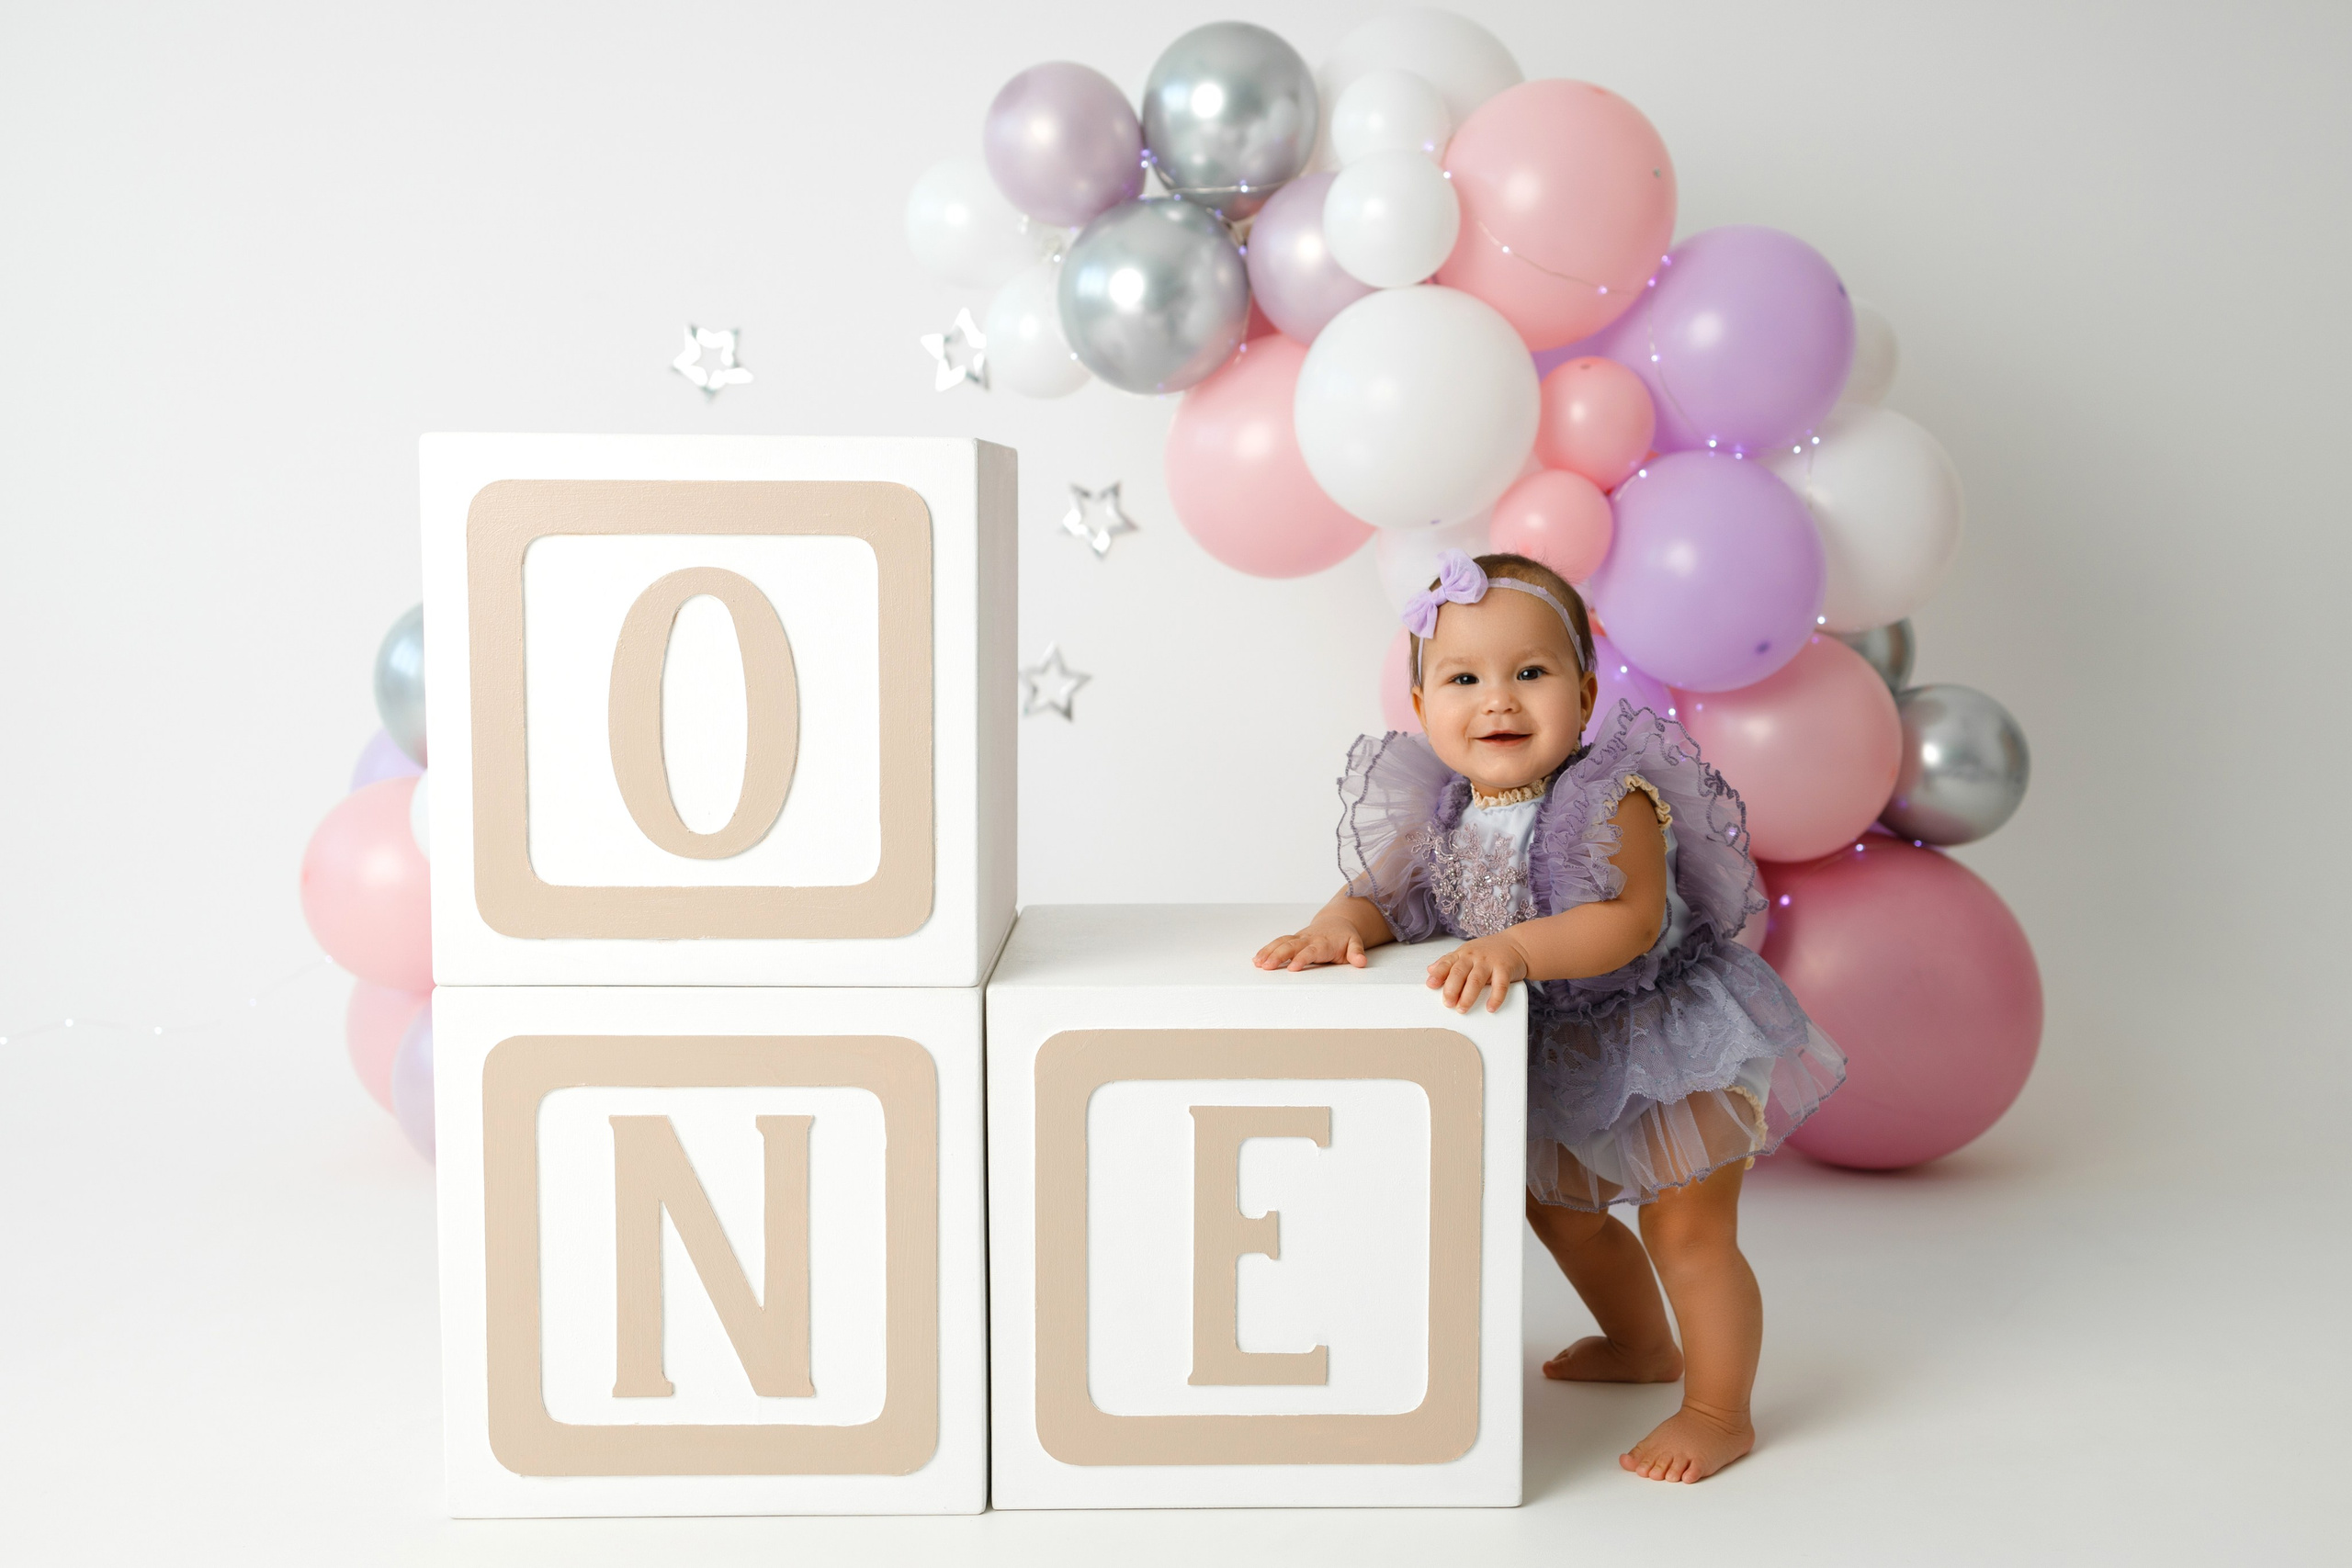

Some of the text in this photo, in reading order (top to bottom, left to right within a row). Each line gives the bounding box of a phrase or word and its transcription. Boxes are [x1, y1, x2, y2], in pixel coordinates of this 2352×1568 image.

[608, 567, 800, 862] O
[608, 1114, 816, 1398] N
[1188, 1105, 1331, 1387] E
